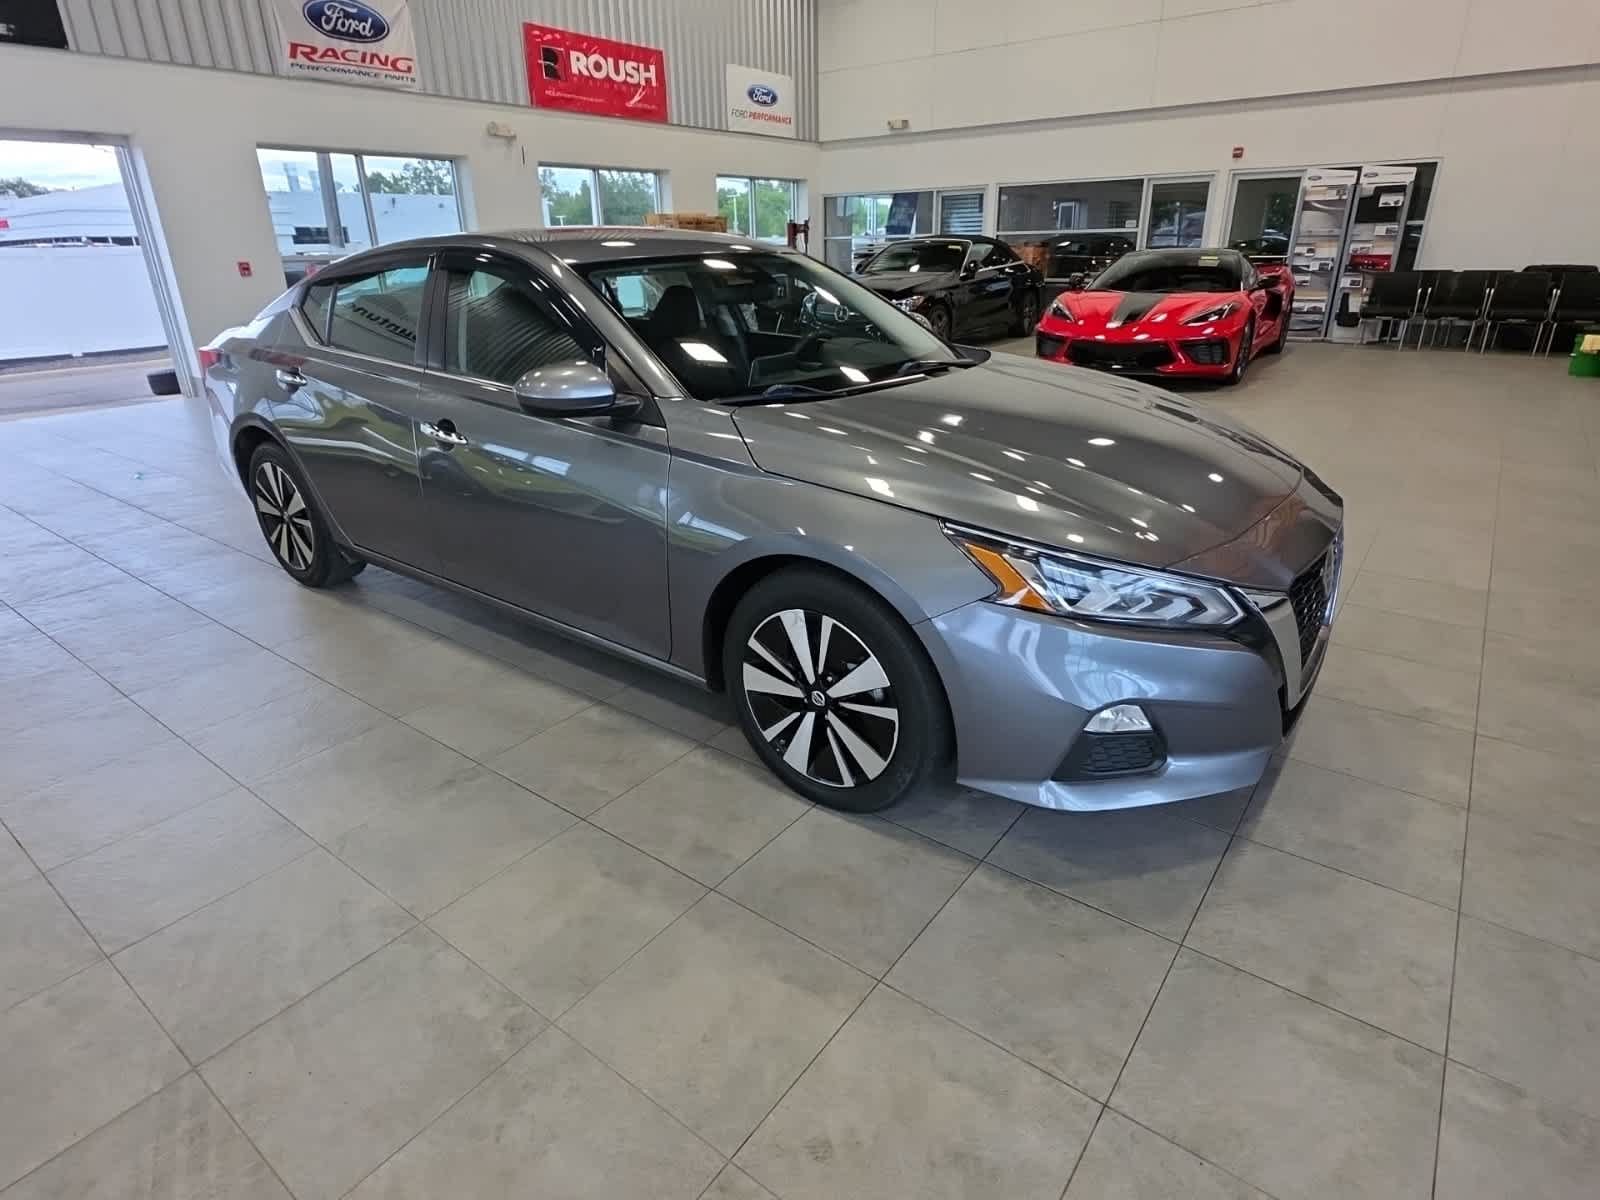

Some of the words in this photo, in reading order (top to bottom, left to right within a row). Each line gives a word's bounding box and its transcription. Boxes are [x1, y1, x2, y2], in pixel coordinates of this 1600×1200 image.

[321, 2, 374, 37] Ford
[289, 42, 414, 74] RACING
[290, 62, 380, 79] PERFORMANCE
[569, 50, 657, 87] ROUSH
[752, 87, 773, 104] Ford
